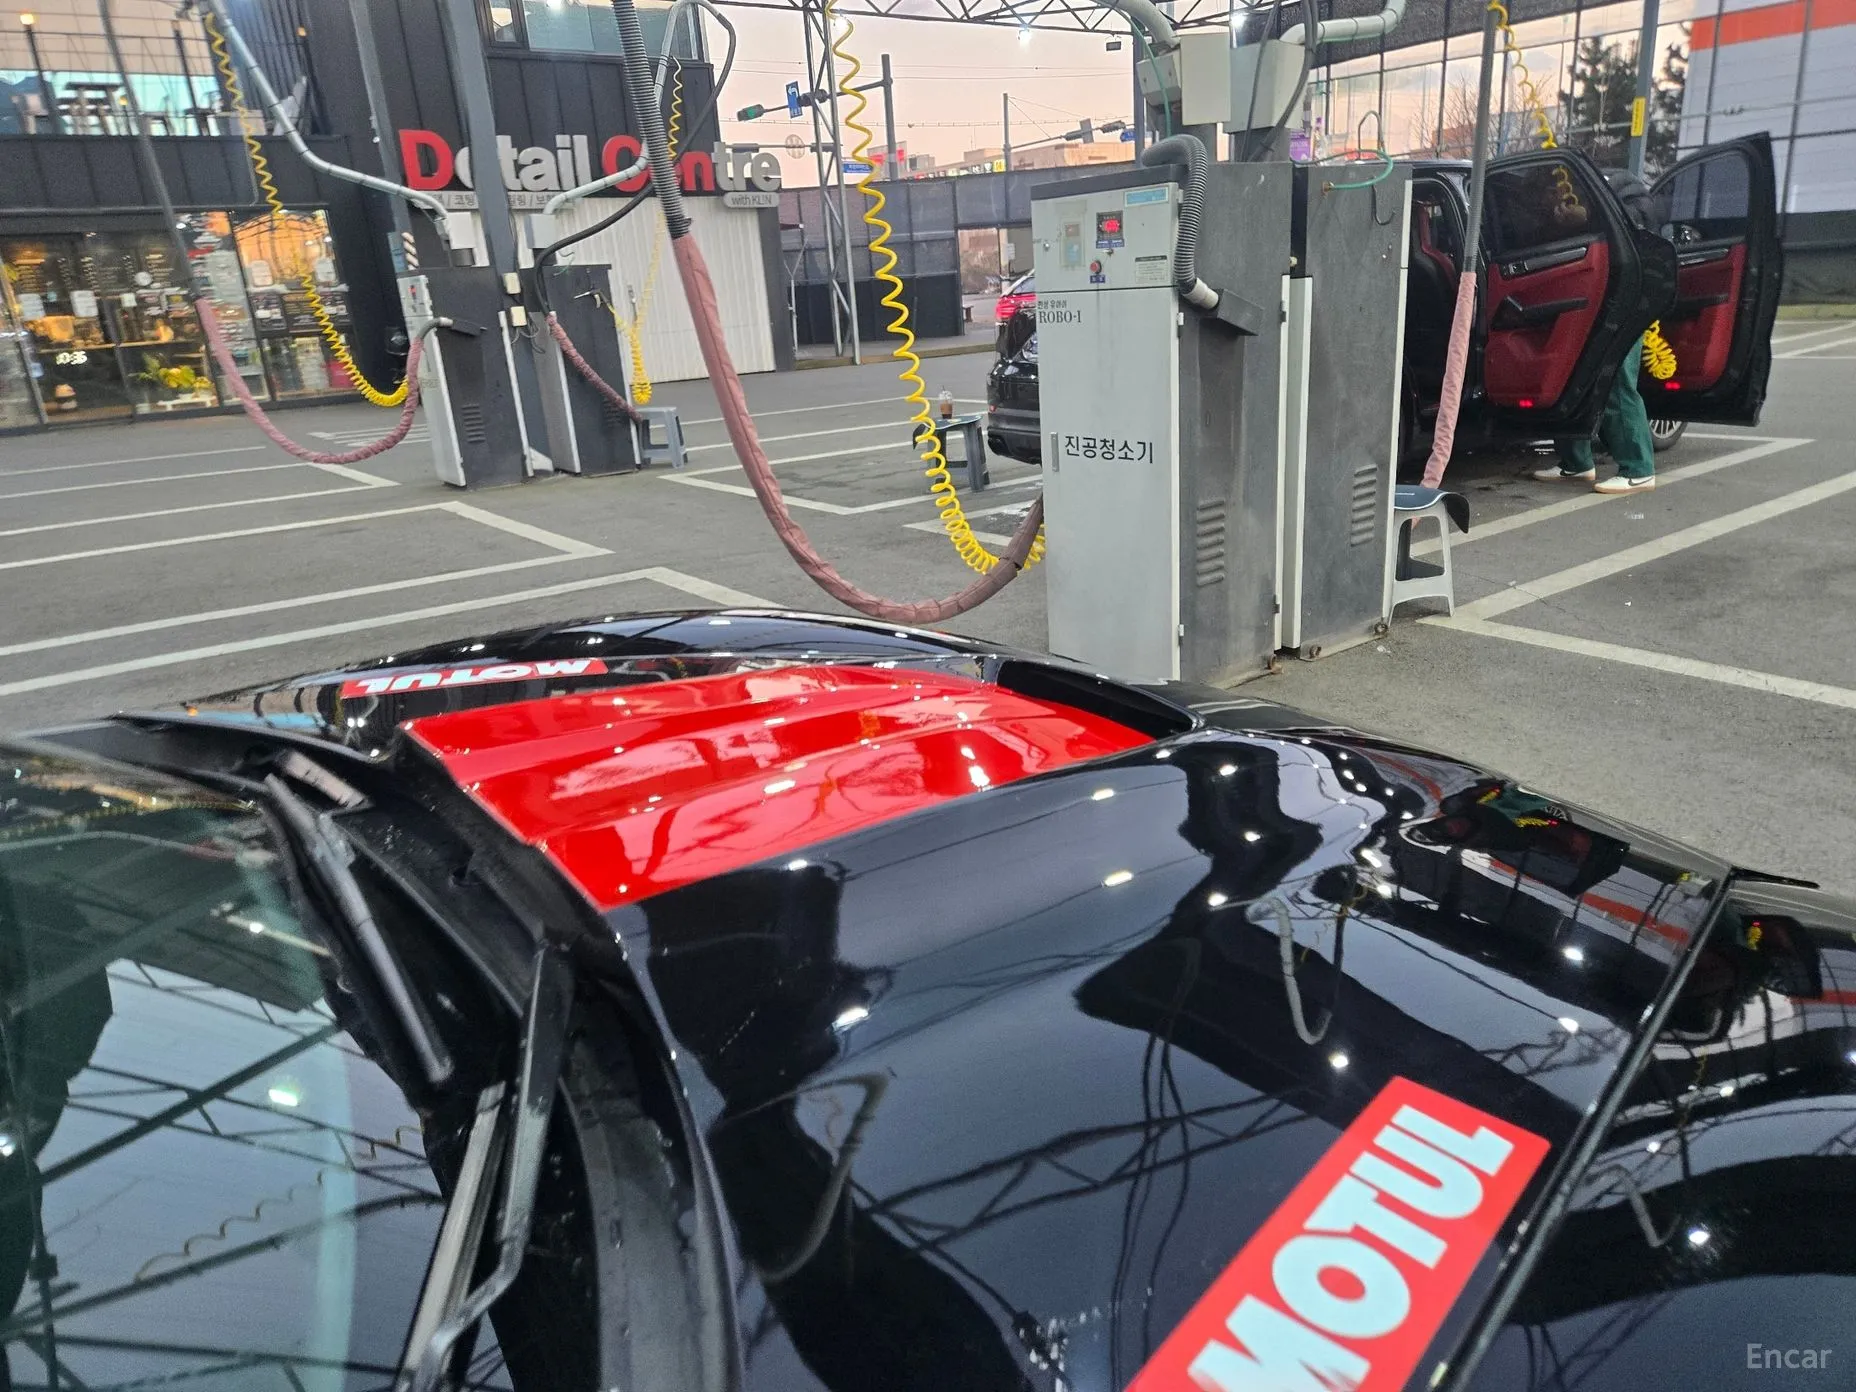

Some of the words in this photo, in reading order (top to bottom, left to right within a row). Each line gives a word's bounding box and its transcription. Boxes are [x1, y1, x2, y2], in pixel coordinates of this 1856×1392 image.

[602, 135, 782, 192] Cntre
[731, 194, 751, 205] with
[1065, 436, 1153, 464] 진공청소기
[356, 659, 592, 694] MOTUL
[1187, 1104, 1515, 1392] MOTUL
